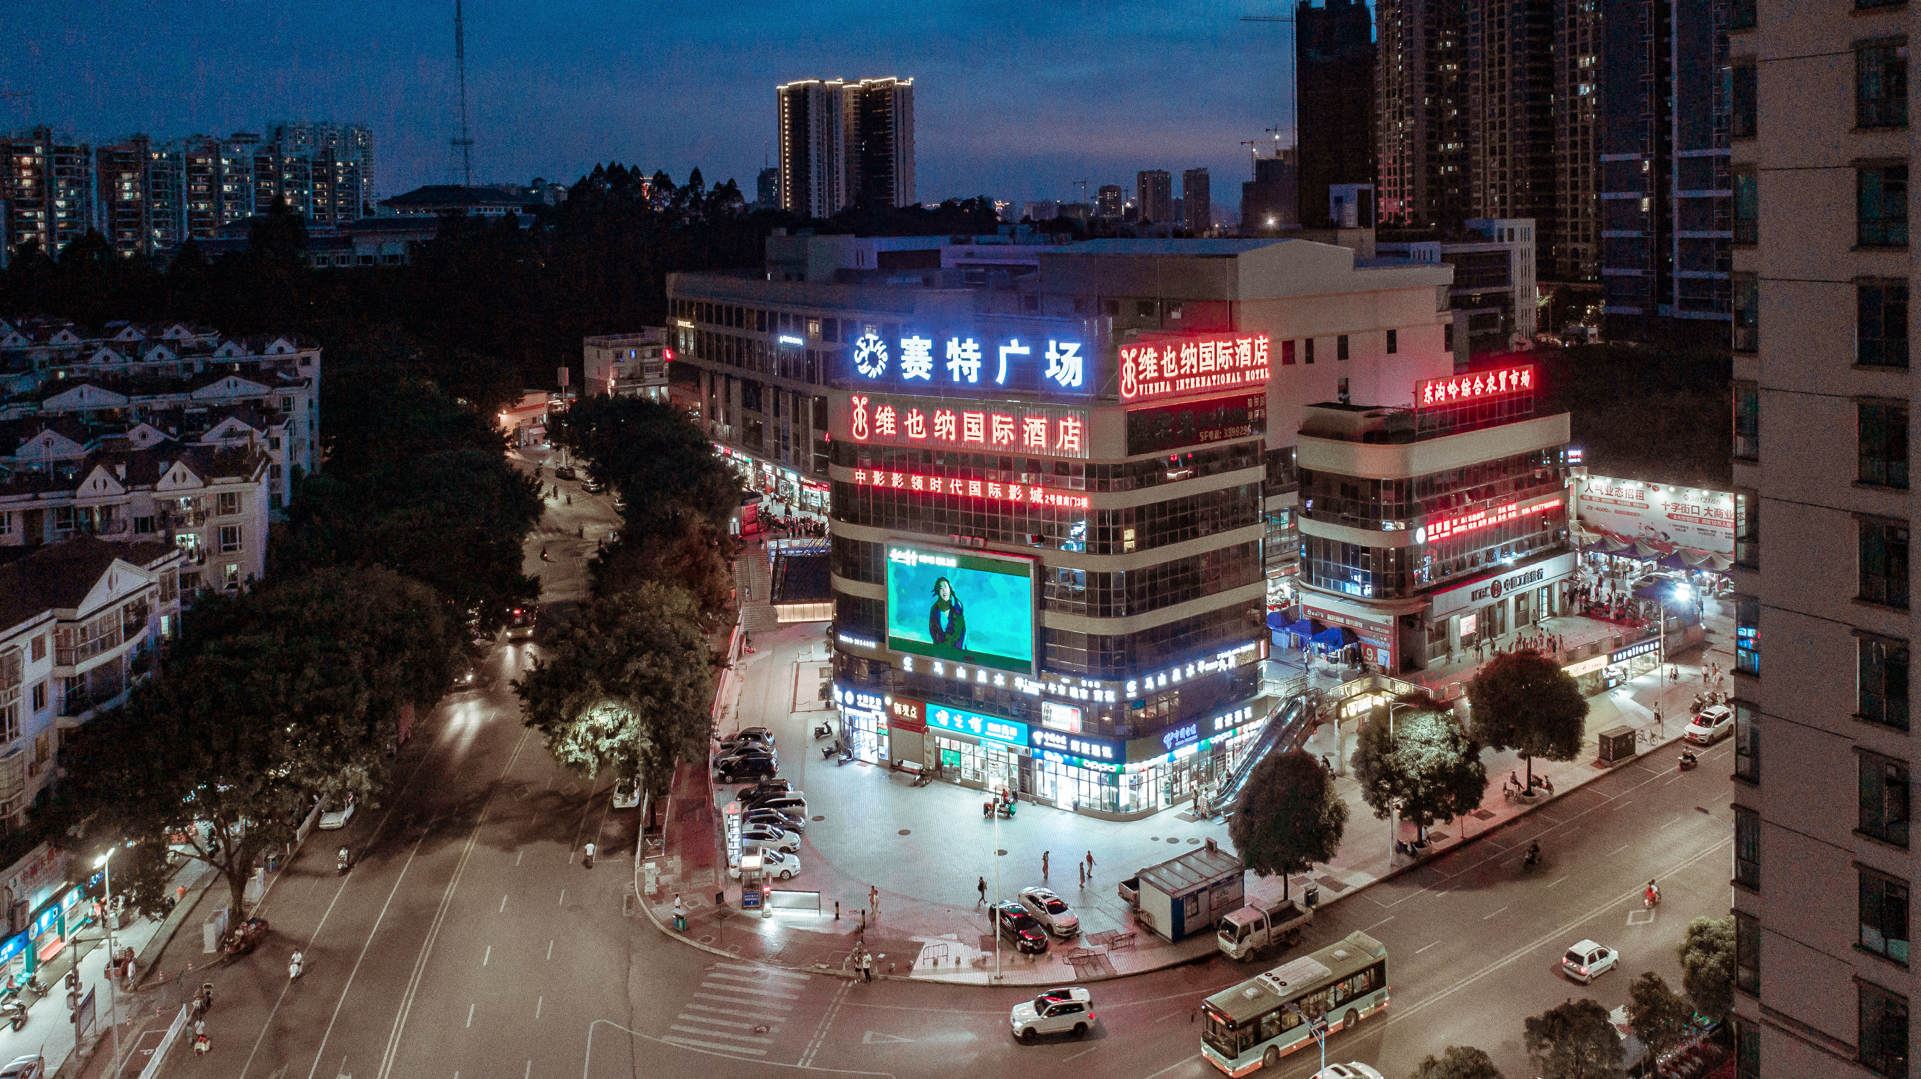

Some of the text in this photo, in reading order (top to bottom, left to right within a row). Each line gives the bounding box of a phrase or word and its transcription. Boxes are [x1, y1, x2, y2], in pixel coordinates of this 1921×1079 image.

[900, 336, 1083, 387] 赛特广场
[1138, 335, 1269, 380] 维也纳国际酒店
[1139, 368, 1270, 395] VIENNA INTERNATIONAL HOTEL
[875, 405, 1081, 451] 维也纳国际酒店
[854, 469, 1043, 504] 中影影领时代国际影城
[1585, 482, 1645, 501] 人气业态招租
[1661, 501, 1700, 516] 十字街口
